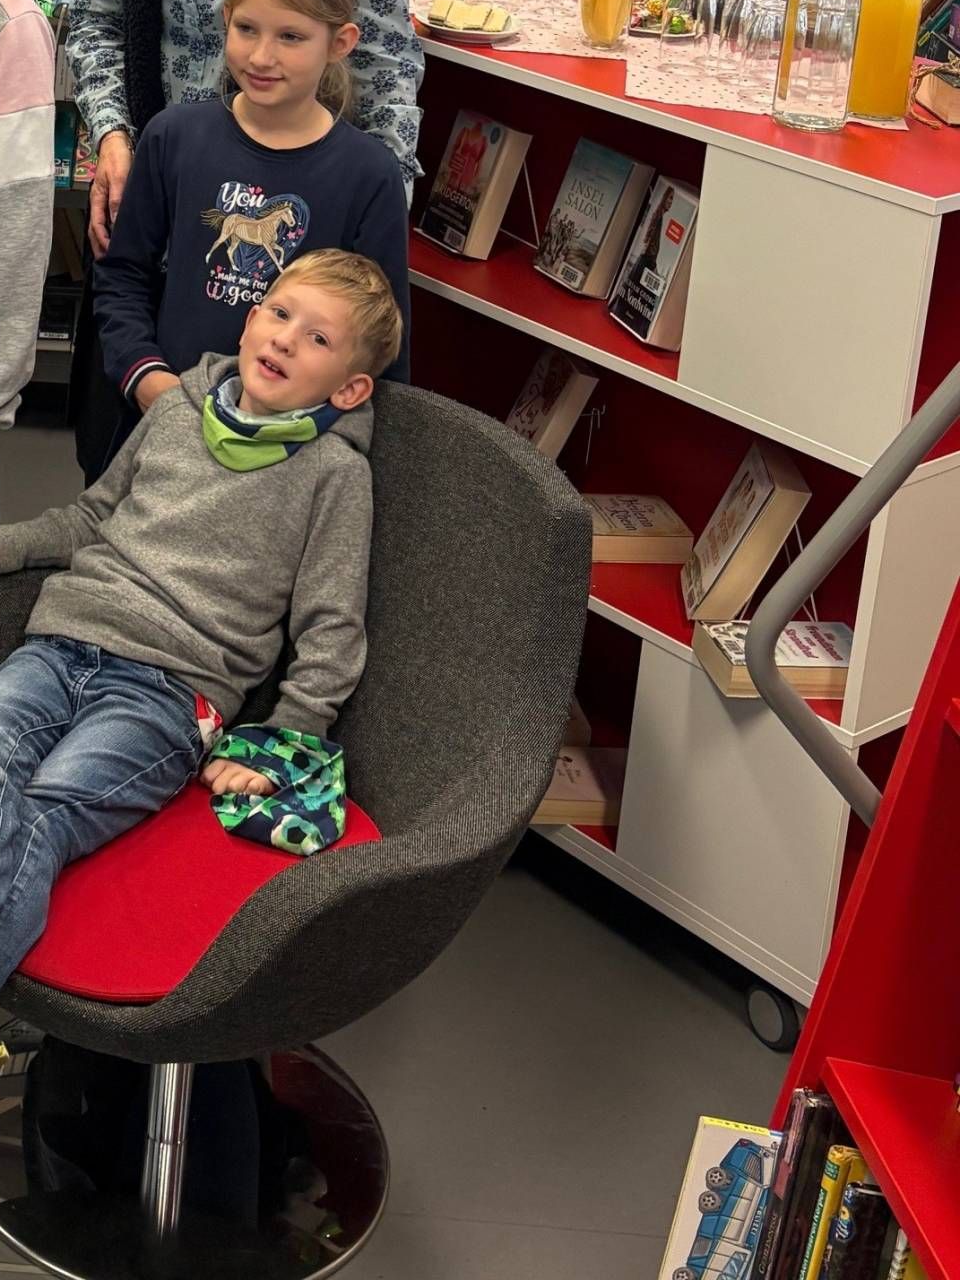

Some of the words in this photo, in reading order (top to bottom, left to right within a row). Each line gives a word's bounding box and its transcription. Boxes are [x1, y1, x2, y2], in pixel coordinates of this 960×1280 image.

[221, 181, 268, 213] You
[565, 192, 600, 220] SALON
[571, 178, 605, 207] INSEL
[228, 286, 267, 306] goo
